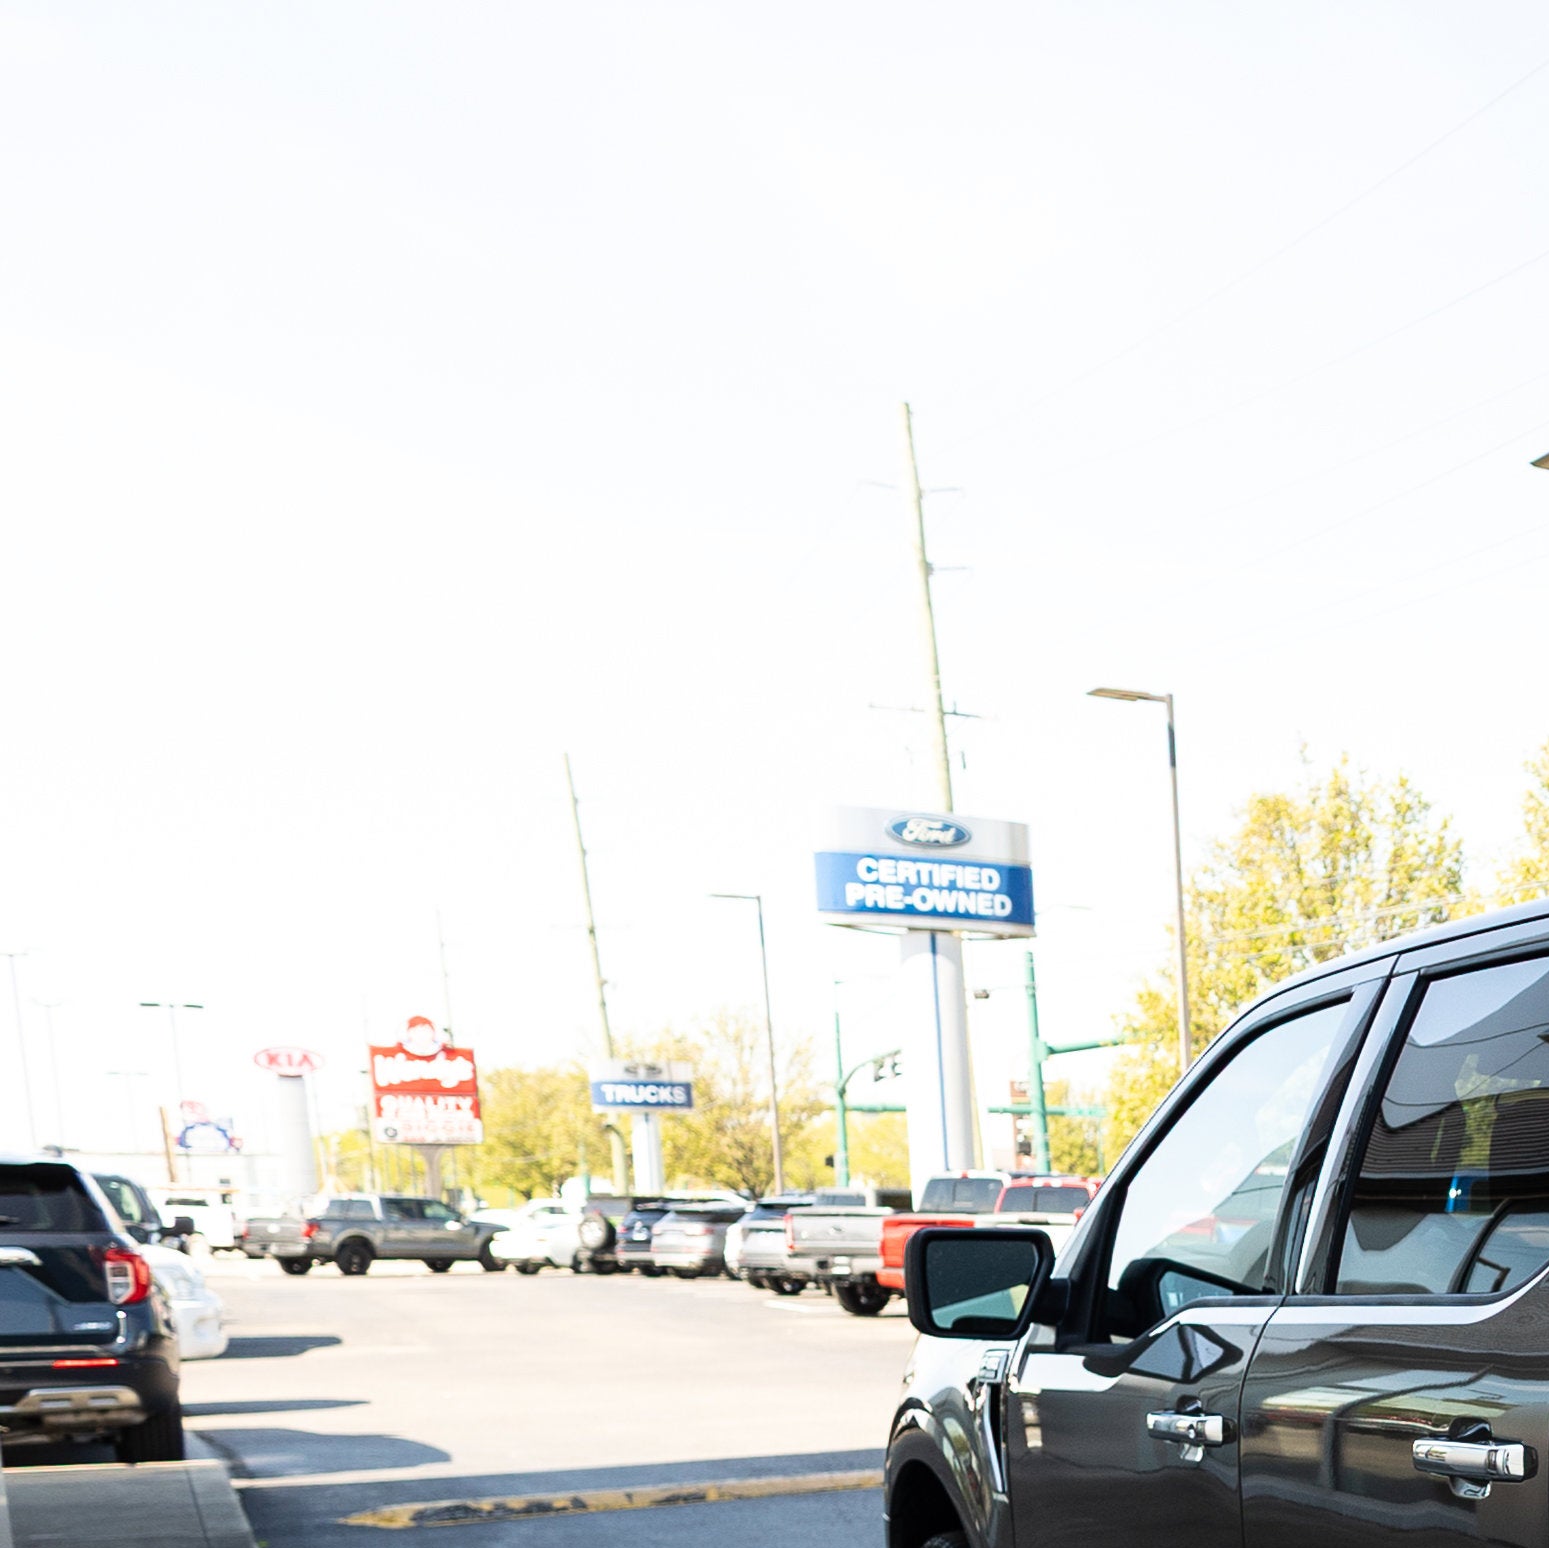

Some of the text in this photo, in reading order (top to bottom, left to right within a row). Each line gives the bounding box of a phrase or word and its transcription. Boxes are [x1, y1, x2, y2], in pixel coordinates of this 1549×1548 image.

[902, 818, 957, 844] Ford
[856, 857, 1001, 892] CERTIFIED
[845, 882, 1013, 917] PRE-OWNED
[266, 1053, 315, 1069] KIA
[601, 1084, 688, 1105] TRUCKS
